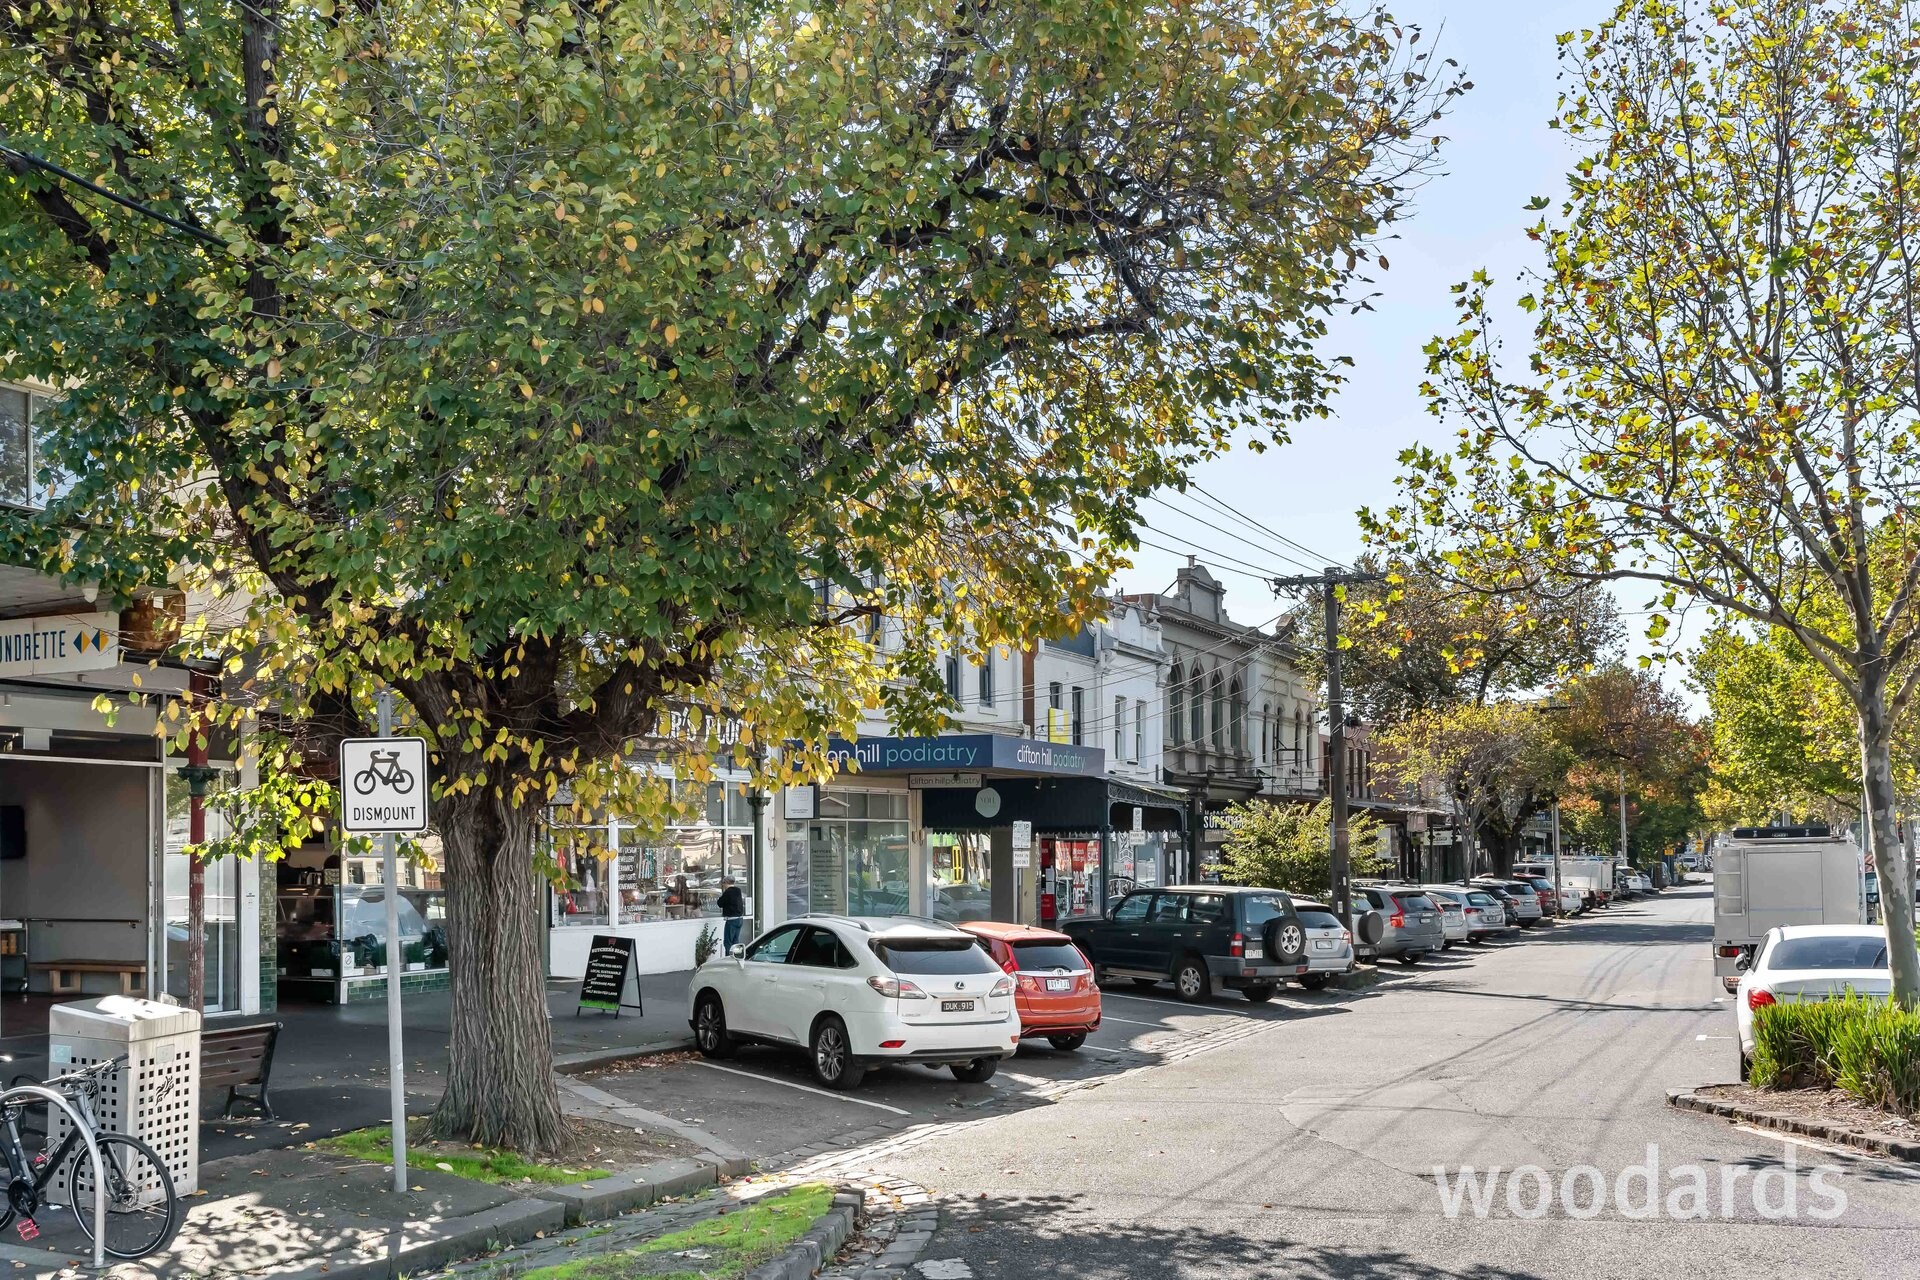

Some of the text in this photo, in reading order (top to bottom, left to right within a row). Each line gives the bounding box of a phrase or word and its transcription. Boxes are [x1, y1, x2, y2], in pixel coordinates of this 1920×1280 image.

[854, 743, 880, 763] hill
[886, 743, 978, 767] podiatry
[1016, 744, 1086, 773] clifton hill podiatry
[911, 776, 981, 787] clifton hill podiatry
[353, 806, 416, 821] DISMOUNT
